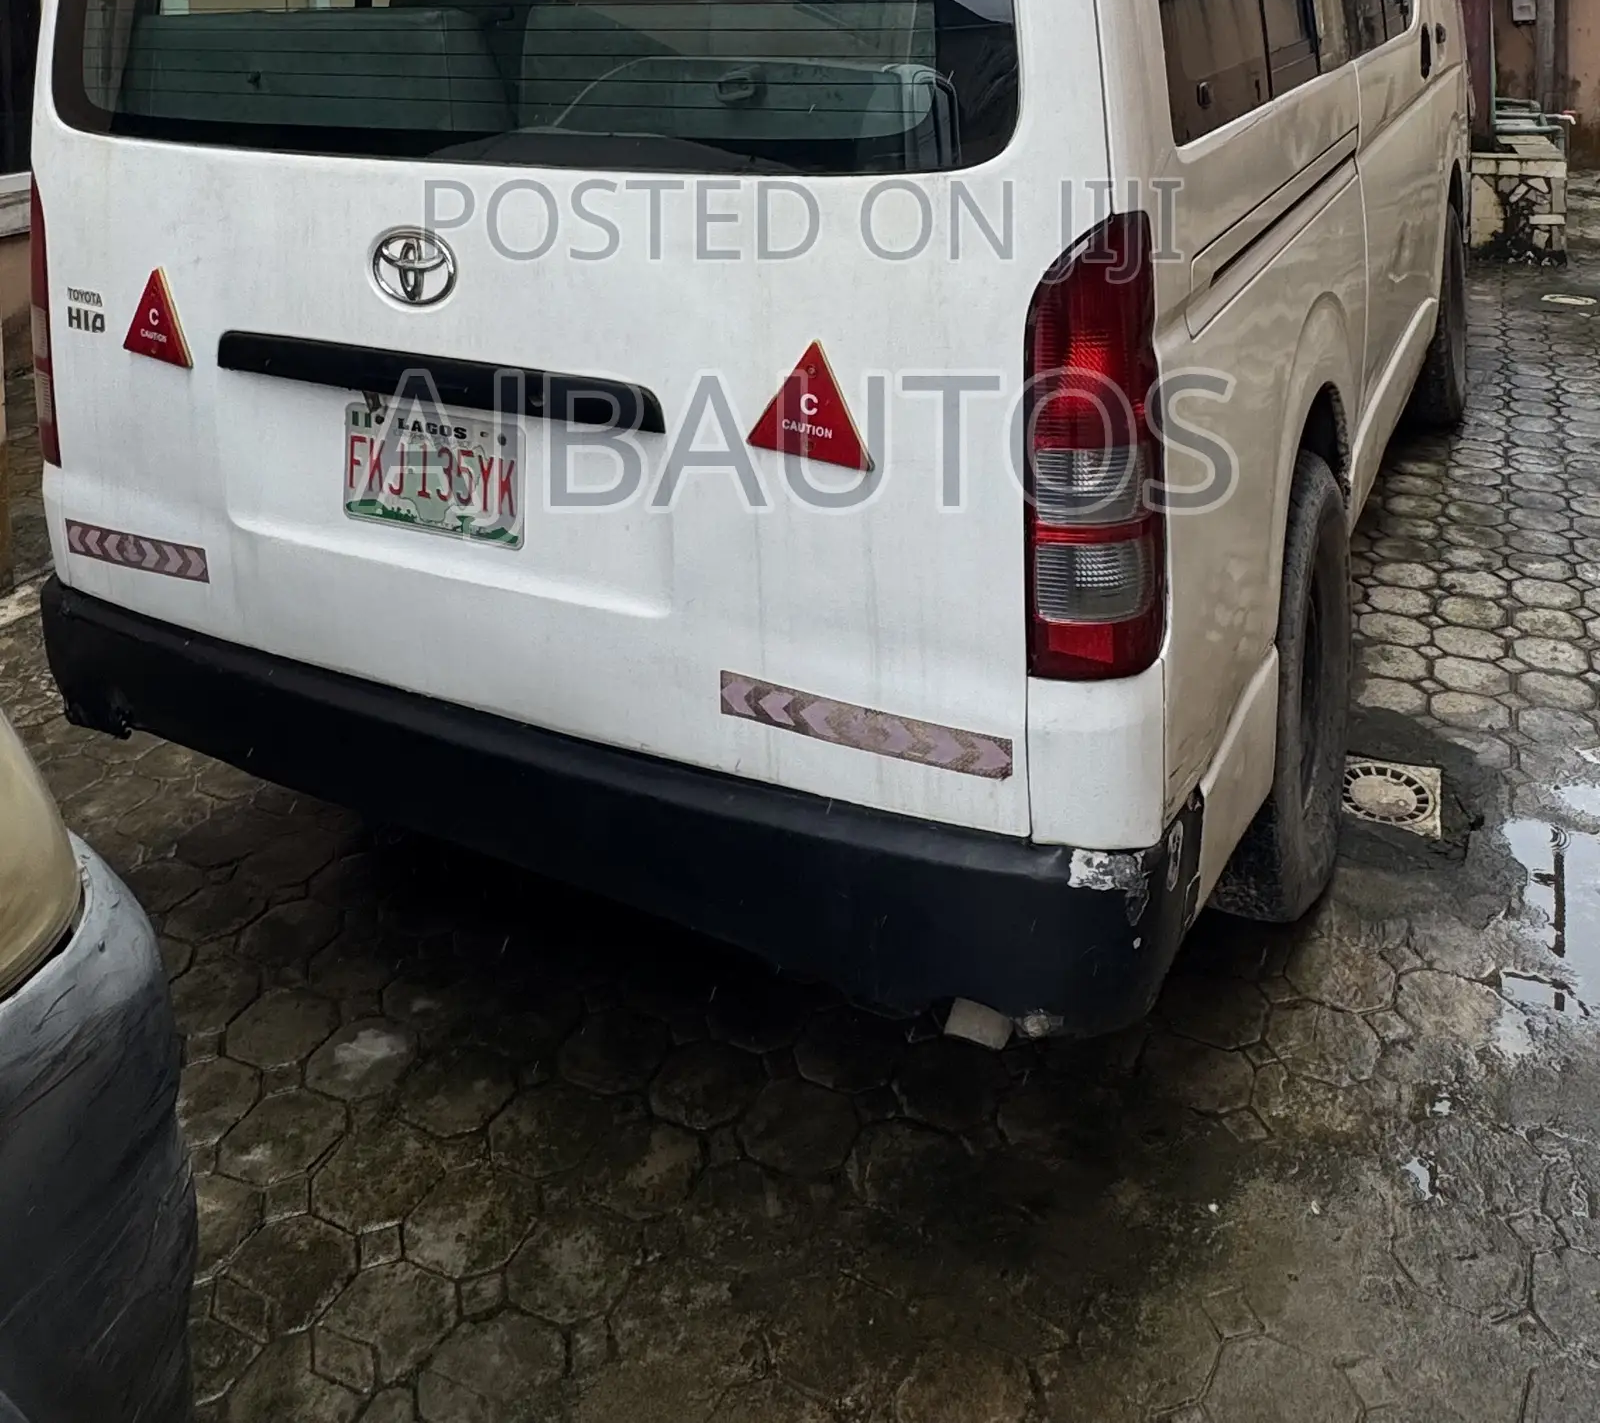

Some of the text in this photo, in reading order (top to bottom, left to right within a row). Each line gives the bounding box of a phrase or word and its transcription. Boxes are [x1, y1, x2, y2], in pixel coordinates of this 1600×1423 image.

[67, 287, 103, 307] TOYOTA
[149, 308, 159, 326] C
[140, 328, 167, 343] CAUTION
[800, 393, 818, 415] C
[398, 418, 467, 439] LAGOS
[781, 418, 833, 439] CAUTION
